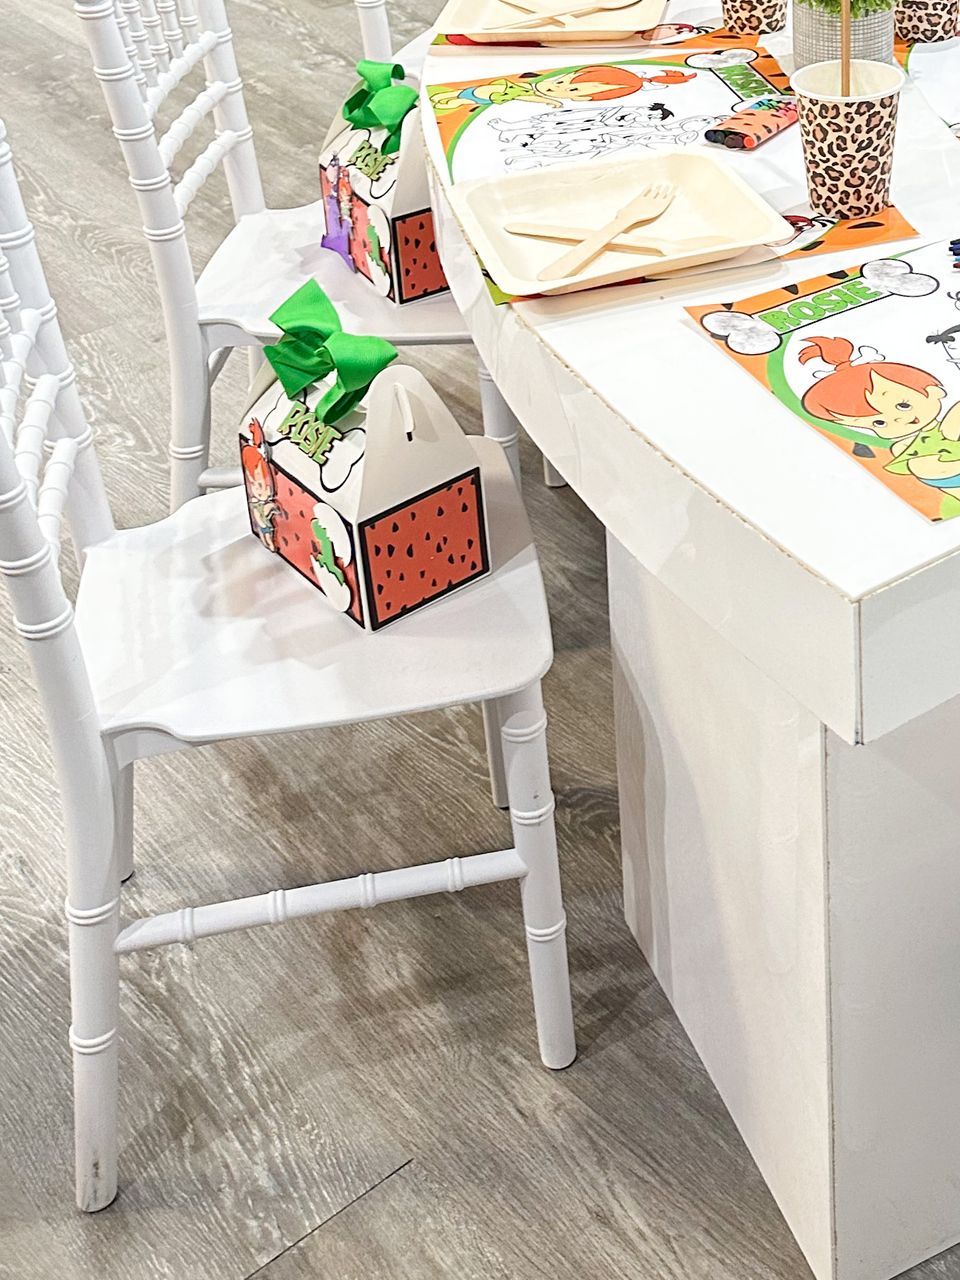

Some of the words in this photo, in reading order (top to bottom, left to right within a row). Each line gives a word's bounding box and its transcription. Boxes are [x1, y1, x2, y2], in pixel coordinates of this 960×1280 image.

[347, 139, 395, 182] ROSIE
[758, 280, 883, 333] ROSIE
[276, 399, 344, 466] ROSIE
